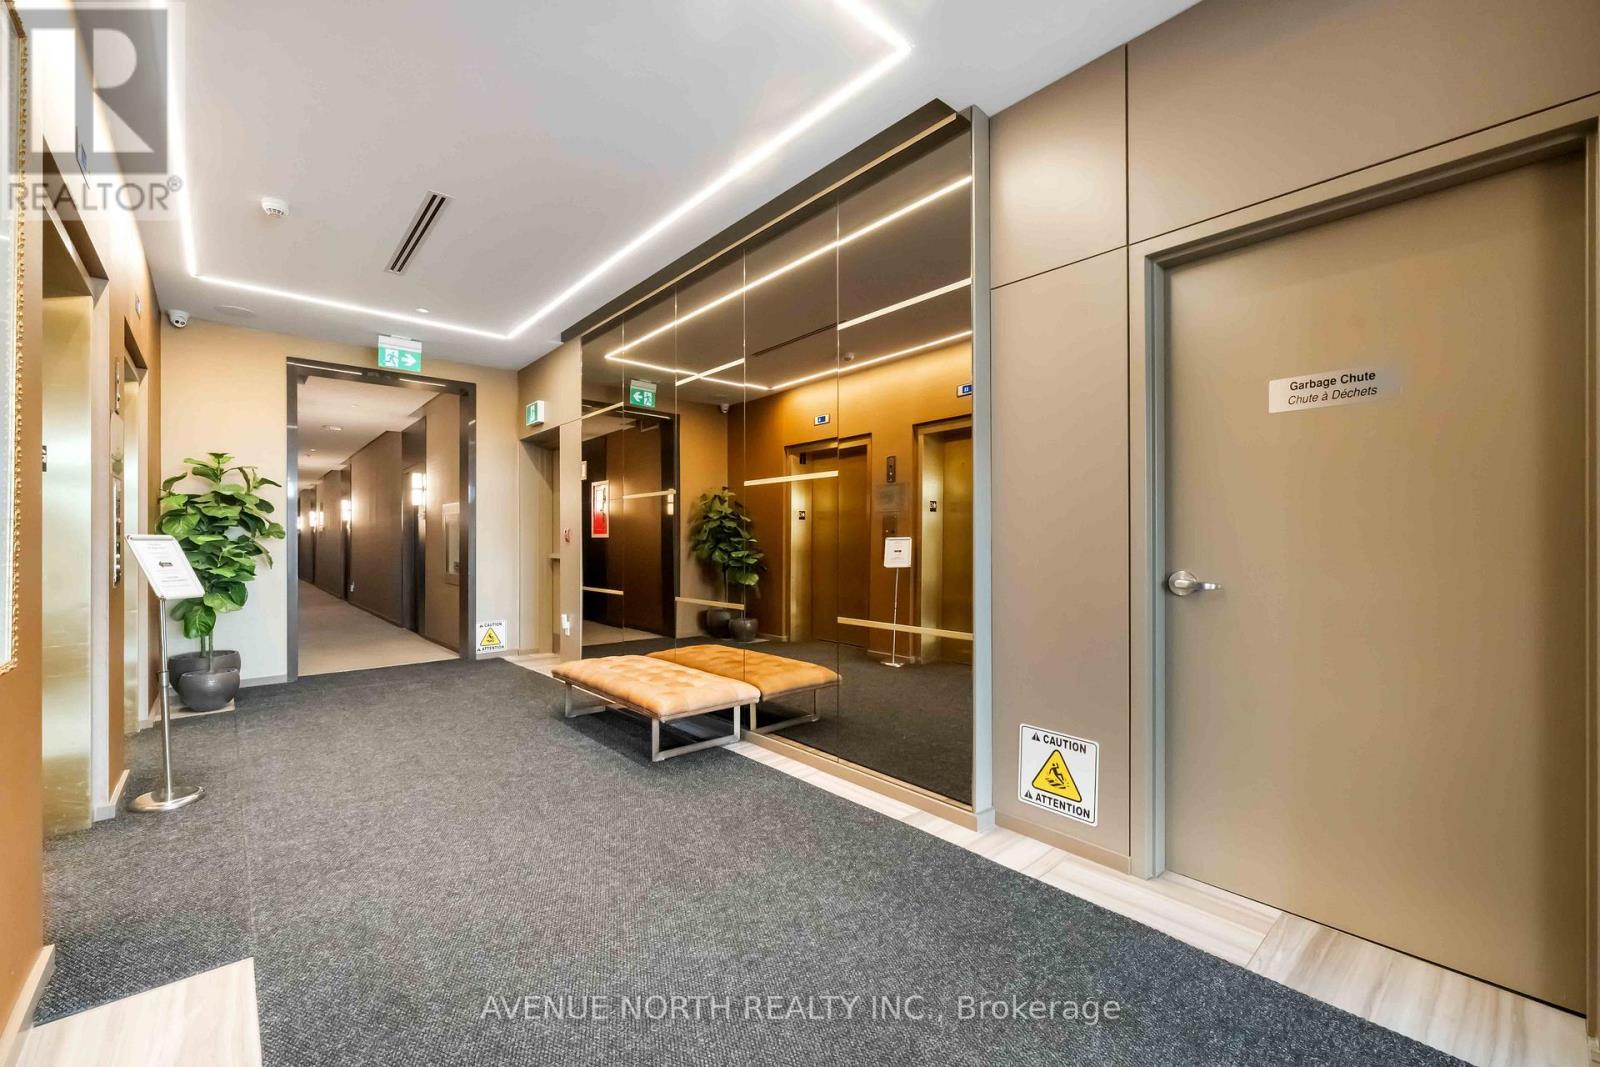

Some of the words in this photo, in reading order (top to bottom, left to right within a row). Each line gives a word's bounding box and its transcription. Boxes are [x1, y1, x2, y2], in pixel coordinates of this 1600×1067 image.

[1290, 377, 1337, 390] Garbage
[1340, 371, 1376, 385] Chute
[1288, 393, 1318, 405] Chute
[1321, 391, 1328, 401] à
[1332, 387, 1378, 400] Déchets
[1043, 734, 1087, 754] CAUTION
[1035, 793, 1090, 819] ATTENTION
